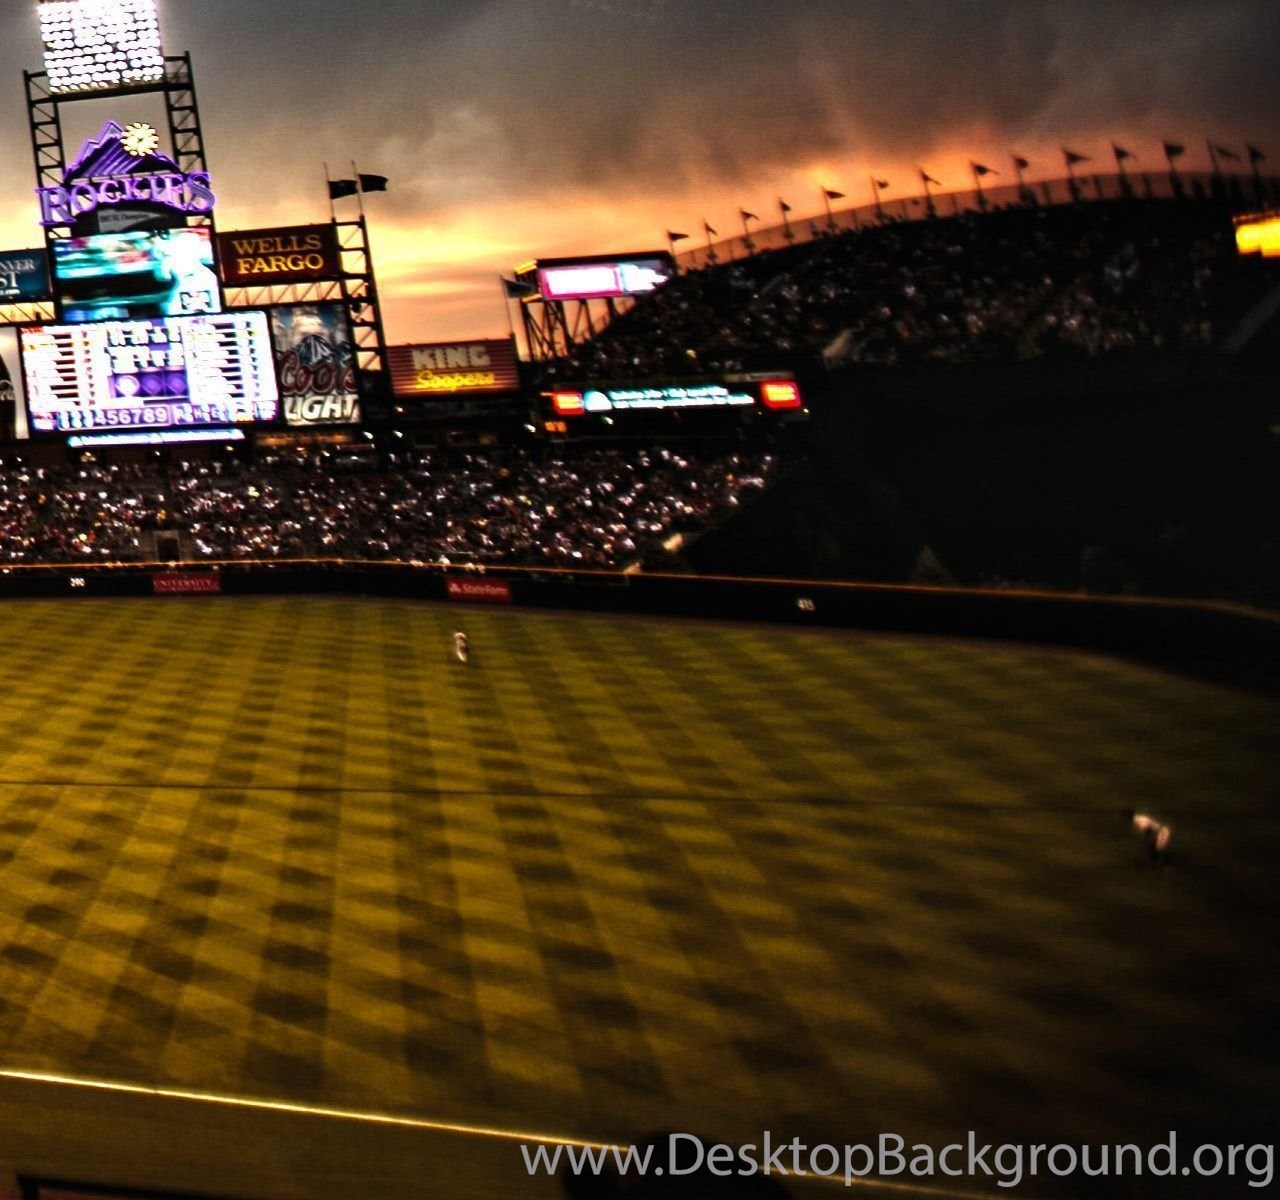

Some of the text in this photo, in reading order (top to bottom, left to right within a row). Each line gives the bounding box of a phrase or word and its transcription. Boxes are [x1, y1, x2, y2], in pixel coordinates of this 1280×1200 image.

[36, 172, 216, 226] ROCKIES
[232, 234, 322, 255] WELLS
[237, 253, 324, 275] FARGO
[412, 346, 491, 370] KING
[280, 349, 358, 395] Coors
[416, 370, 495, 391] Soopers
[283, 394, 359, 420] LIGHT
[153, 578, 212, 587] UNIVERSITY
